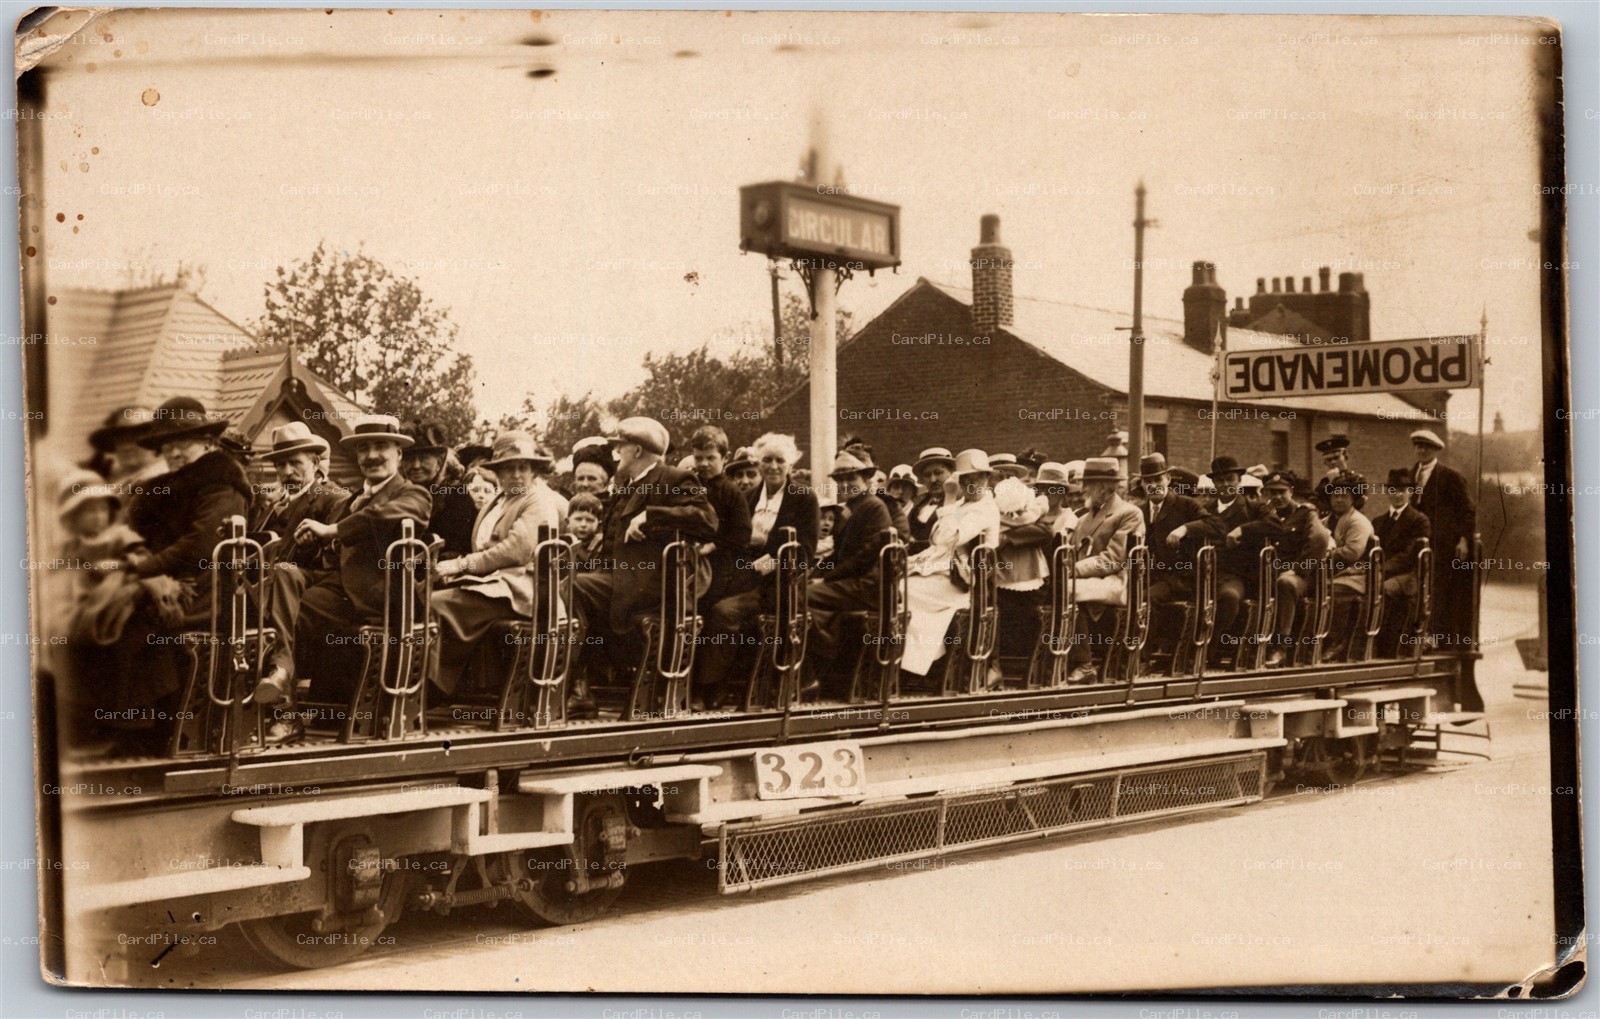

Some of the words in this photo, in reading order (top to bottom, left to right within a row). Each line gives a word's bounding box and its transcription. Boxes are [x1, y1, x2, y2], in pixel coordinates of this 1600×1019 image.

[788, 207, 887, 254] CIRCULAR
[1228, 343, 1467, 394] PROMENADE
[761, 748, 858, 794] 323
